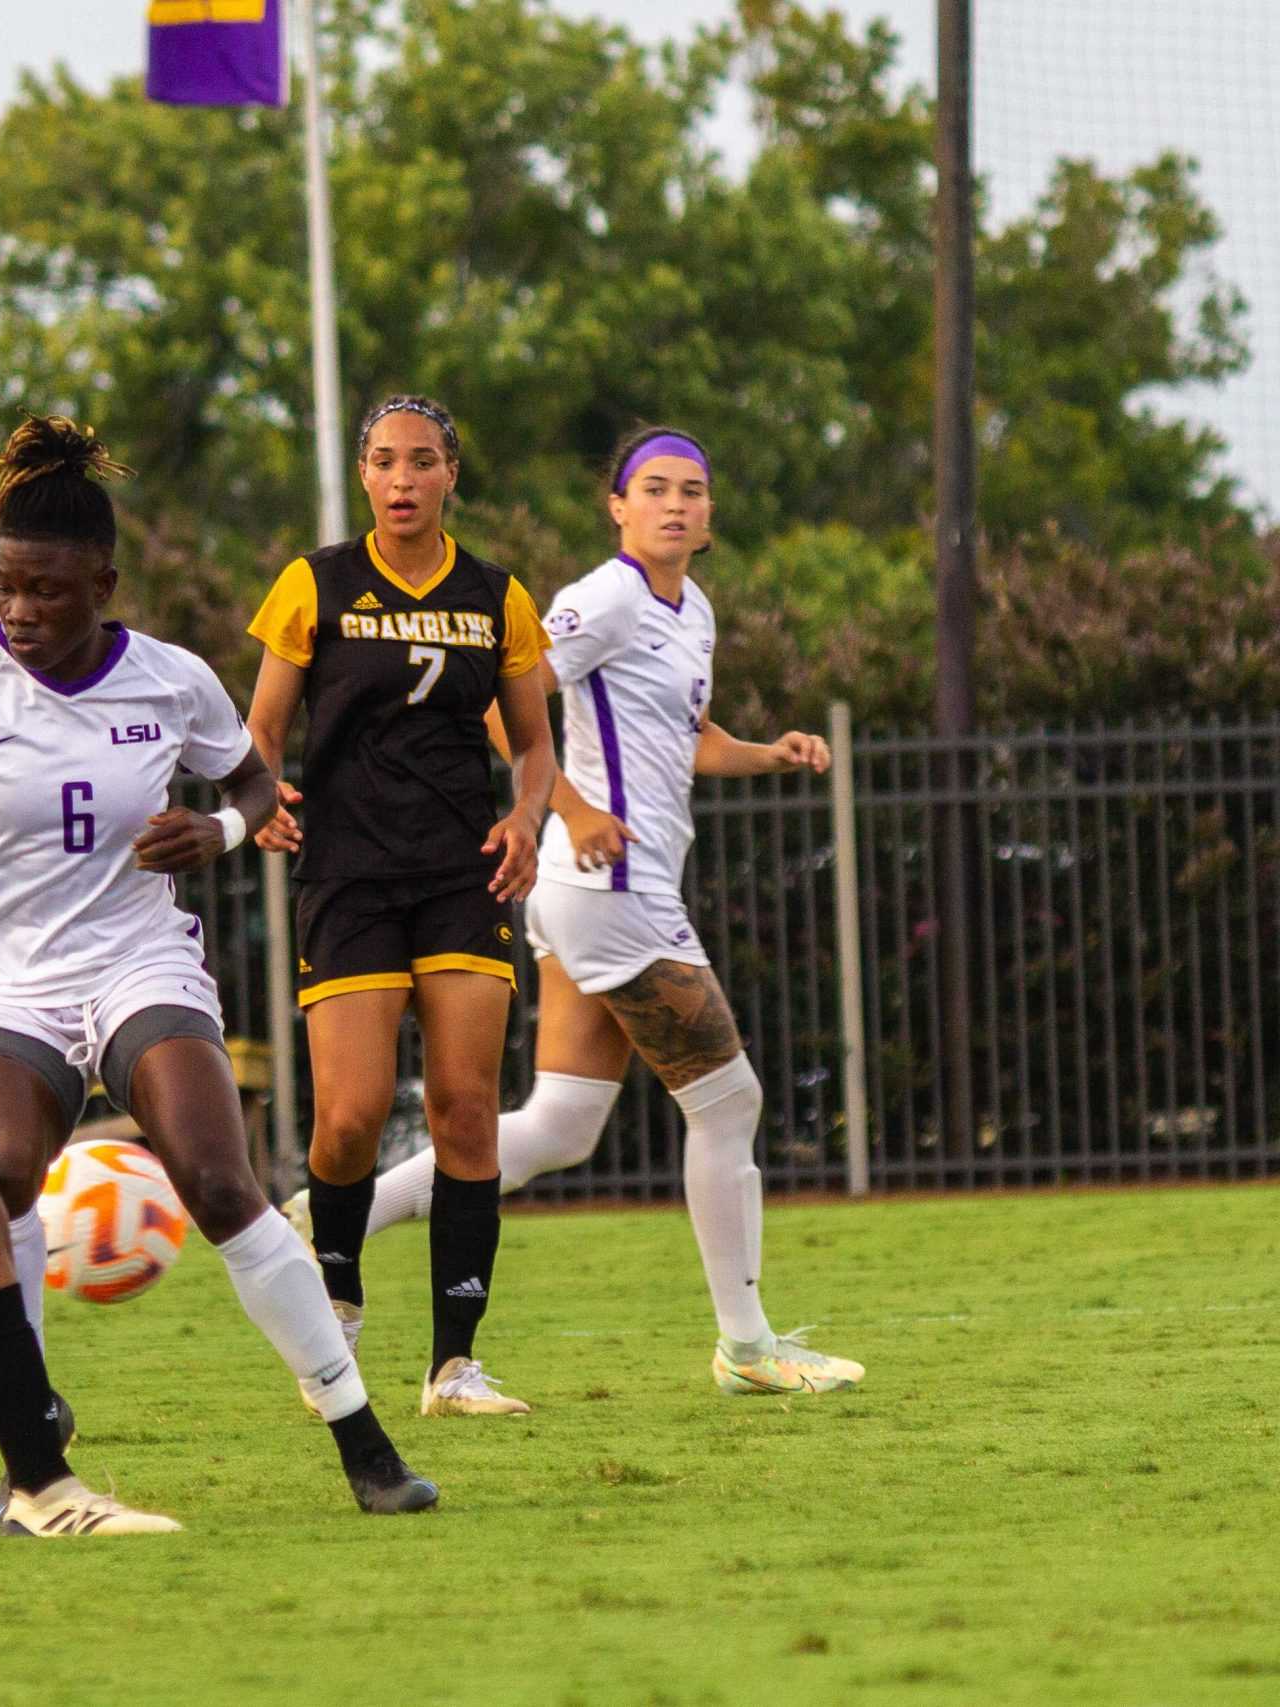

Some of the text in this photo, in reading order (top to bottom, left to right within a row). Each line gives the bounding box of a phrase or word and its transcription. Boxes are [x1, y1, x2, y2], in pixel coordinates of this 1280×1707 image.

[407, 644, 446, 705] 7
[110, 723, 161, 745] LSU
[62, 781, 95, 854] 6
[445, 1289, 487, 1298] adidas
